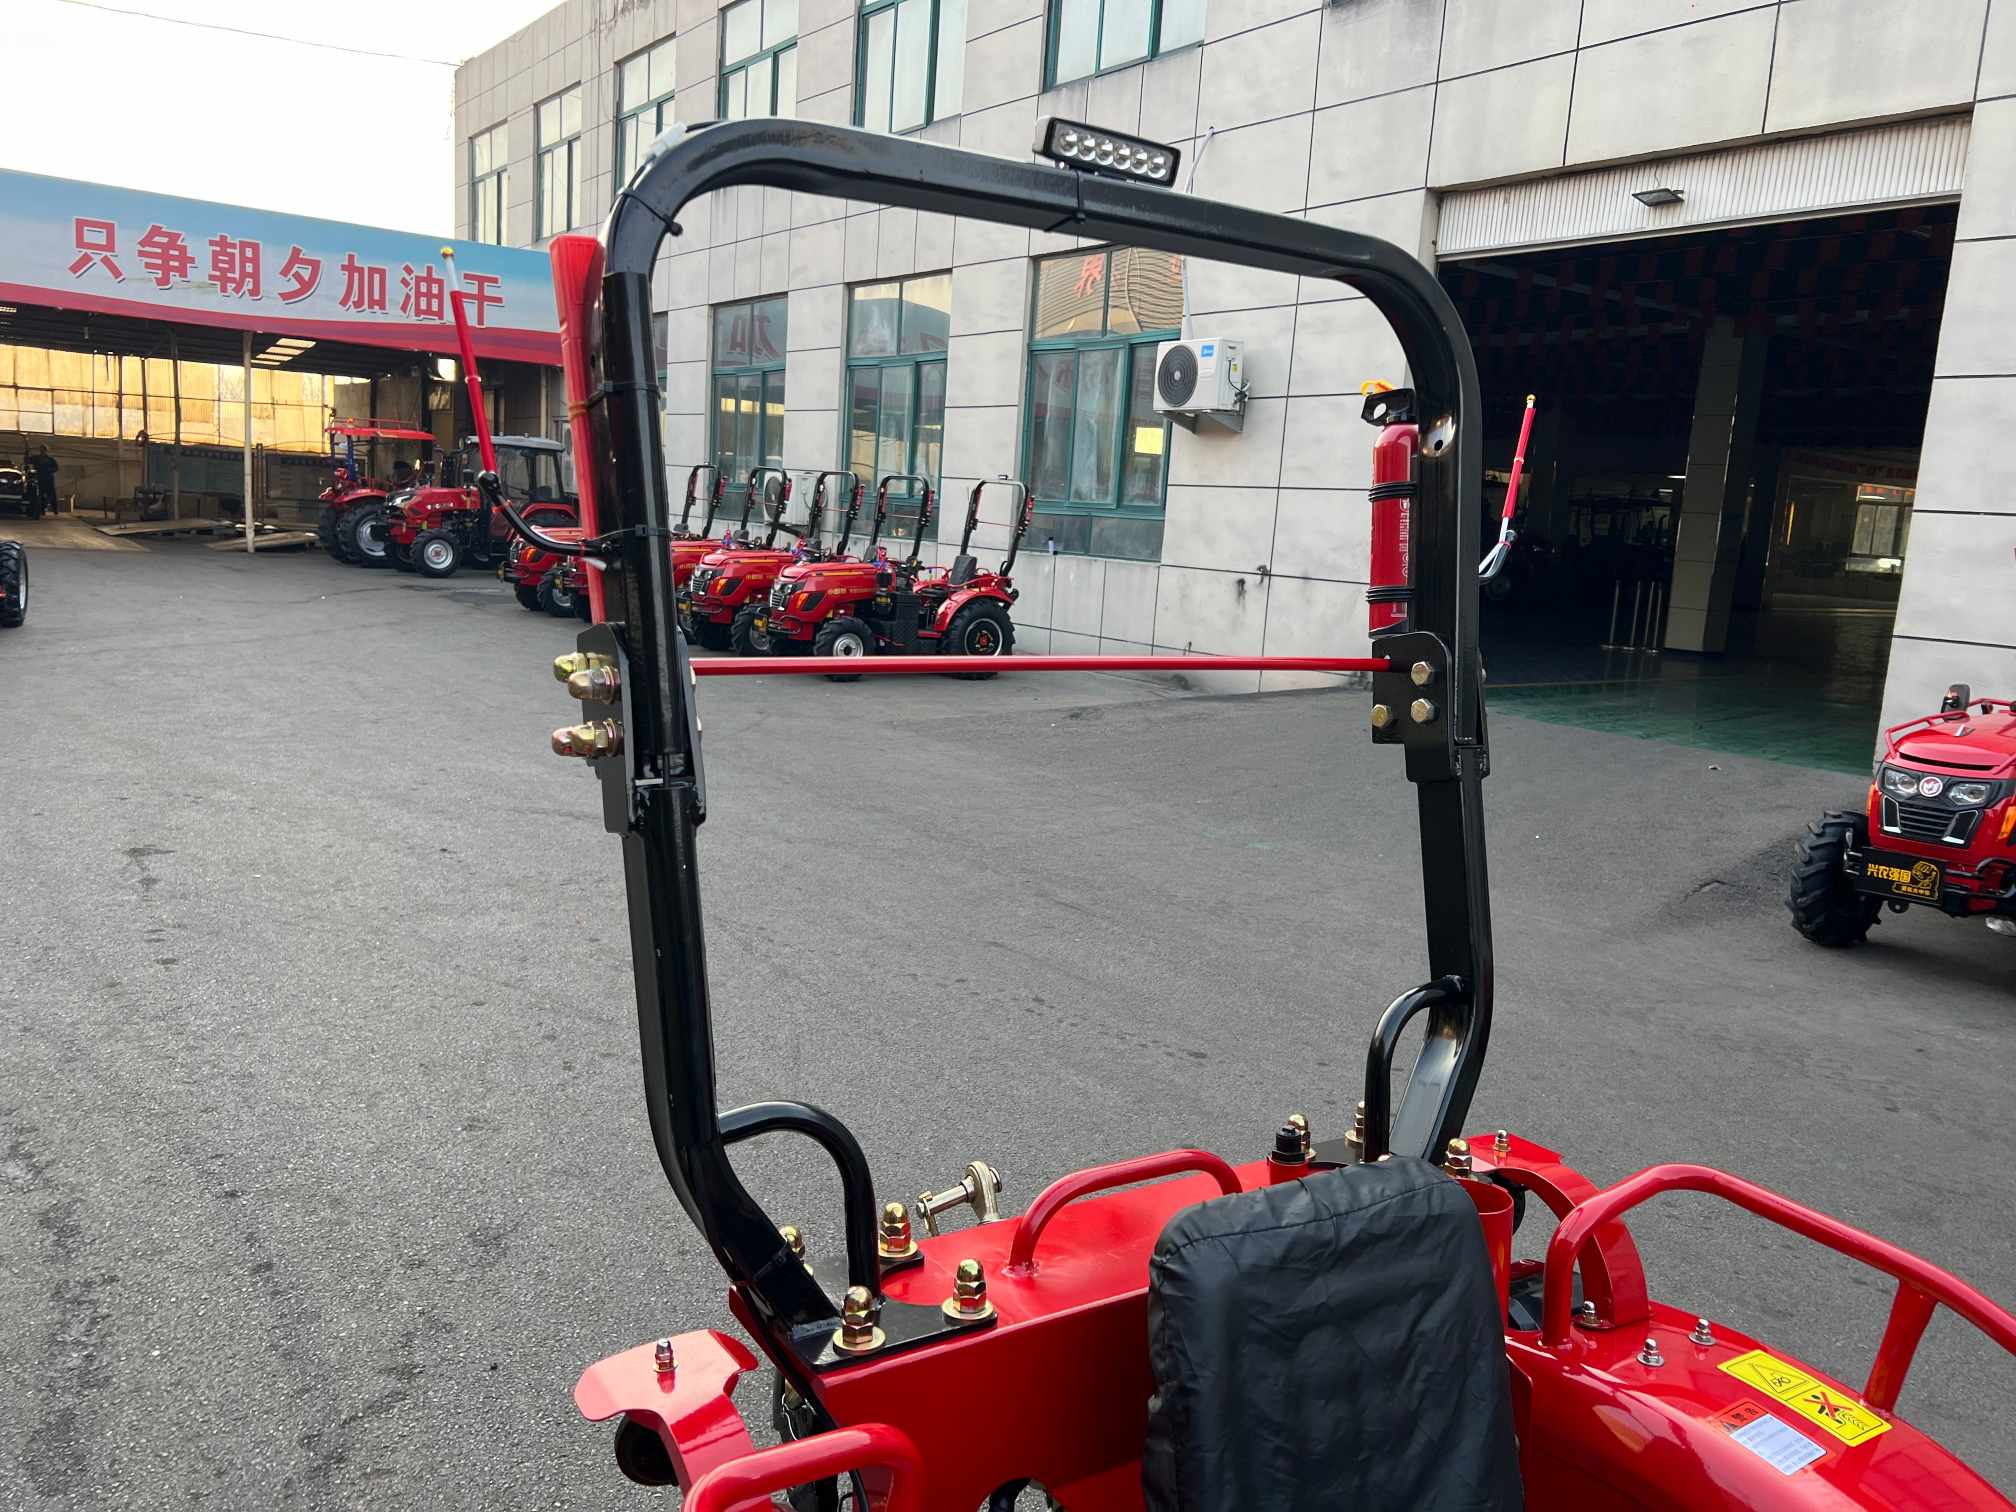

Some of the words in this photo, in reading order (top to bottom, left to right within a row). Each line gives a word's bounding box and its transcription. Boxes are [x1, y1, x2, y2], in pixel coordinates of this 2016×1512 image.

[68, 217, 503, 327] 只争朝夕加油干
